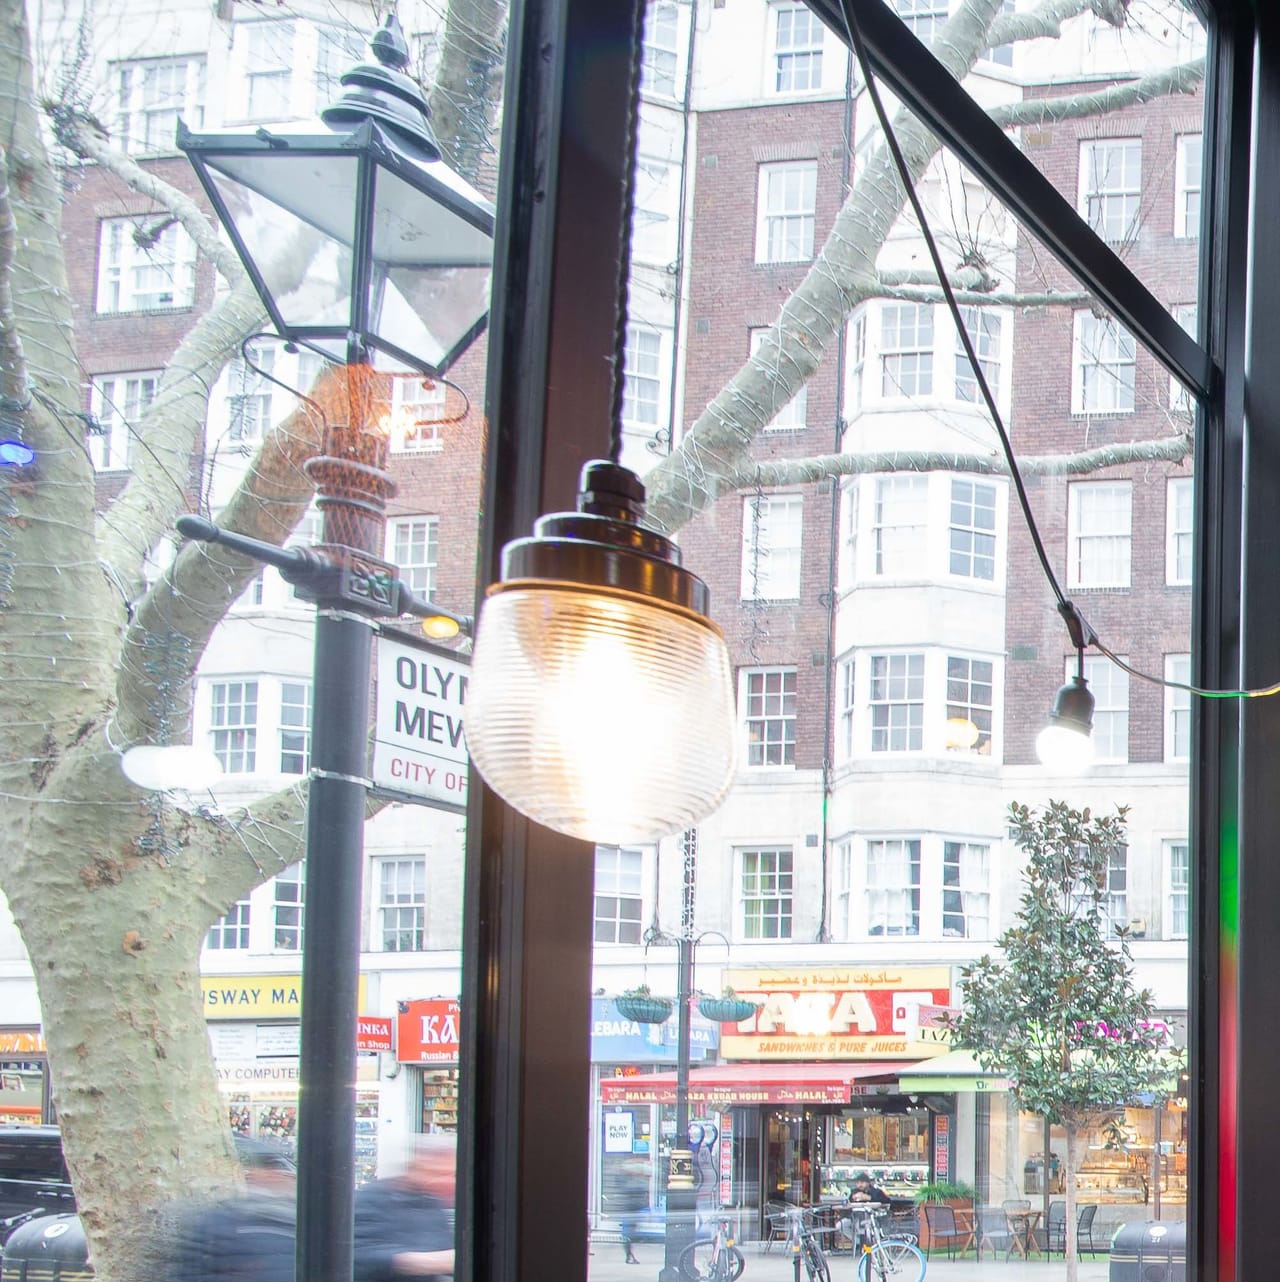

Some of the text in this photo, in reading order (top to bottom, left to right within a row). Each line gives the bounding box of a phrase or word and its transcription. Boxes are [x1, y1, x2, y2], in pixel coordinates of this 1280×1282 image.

[391, 758, 436, 785] CITY
[202, 988, 299, 1005] SWAY MA
[358, 1023, 389, 1036] INKA
[421, 1014, 460, 1044] KA
[367, 1040, 390, 1050] Shop
[839, 1042, 866, 1053] PURE
[871, 1041, 907, 1053] JUICES
[421, 1051, 451, 1060] Russian
[625, 1091, 657, 1100] HALAL
[795, 1090, 827, 1100] HALAL
